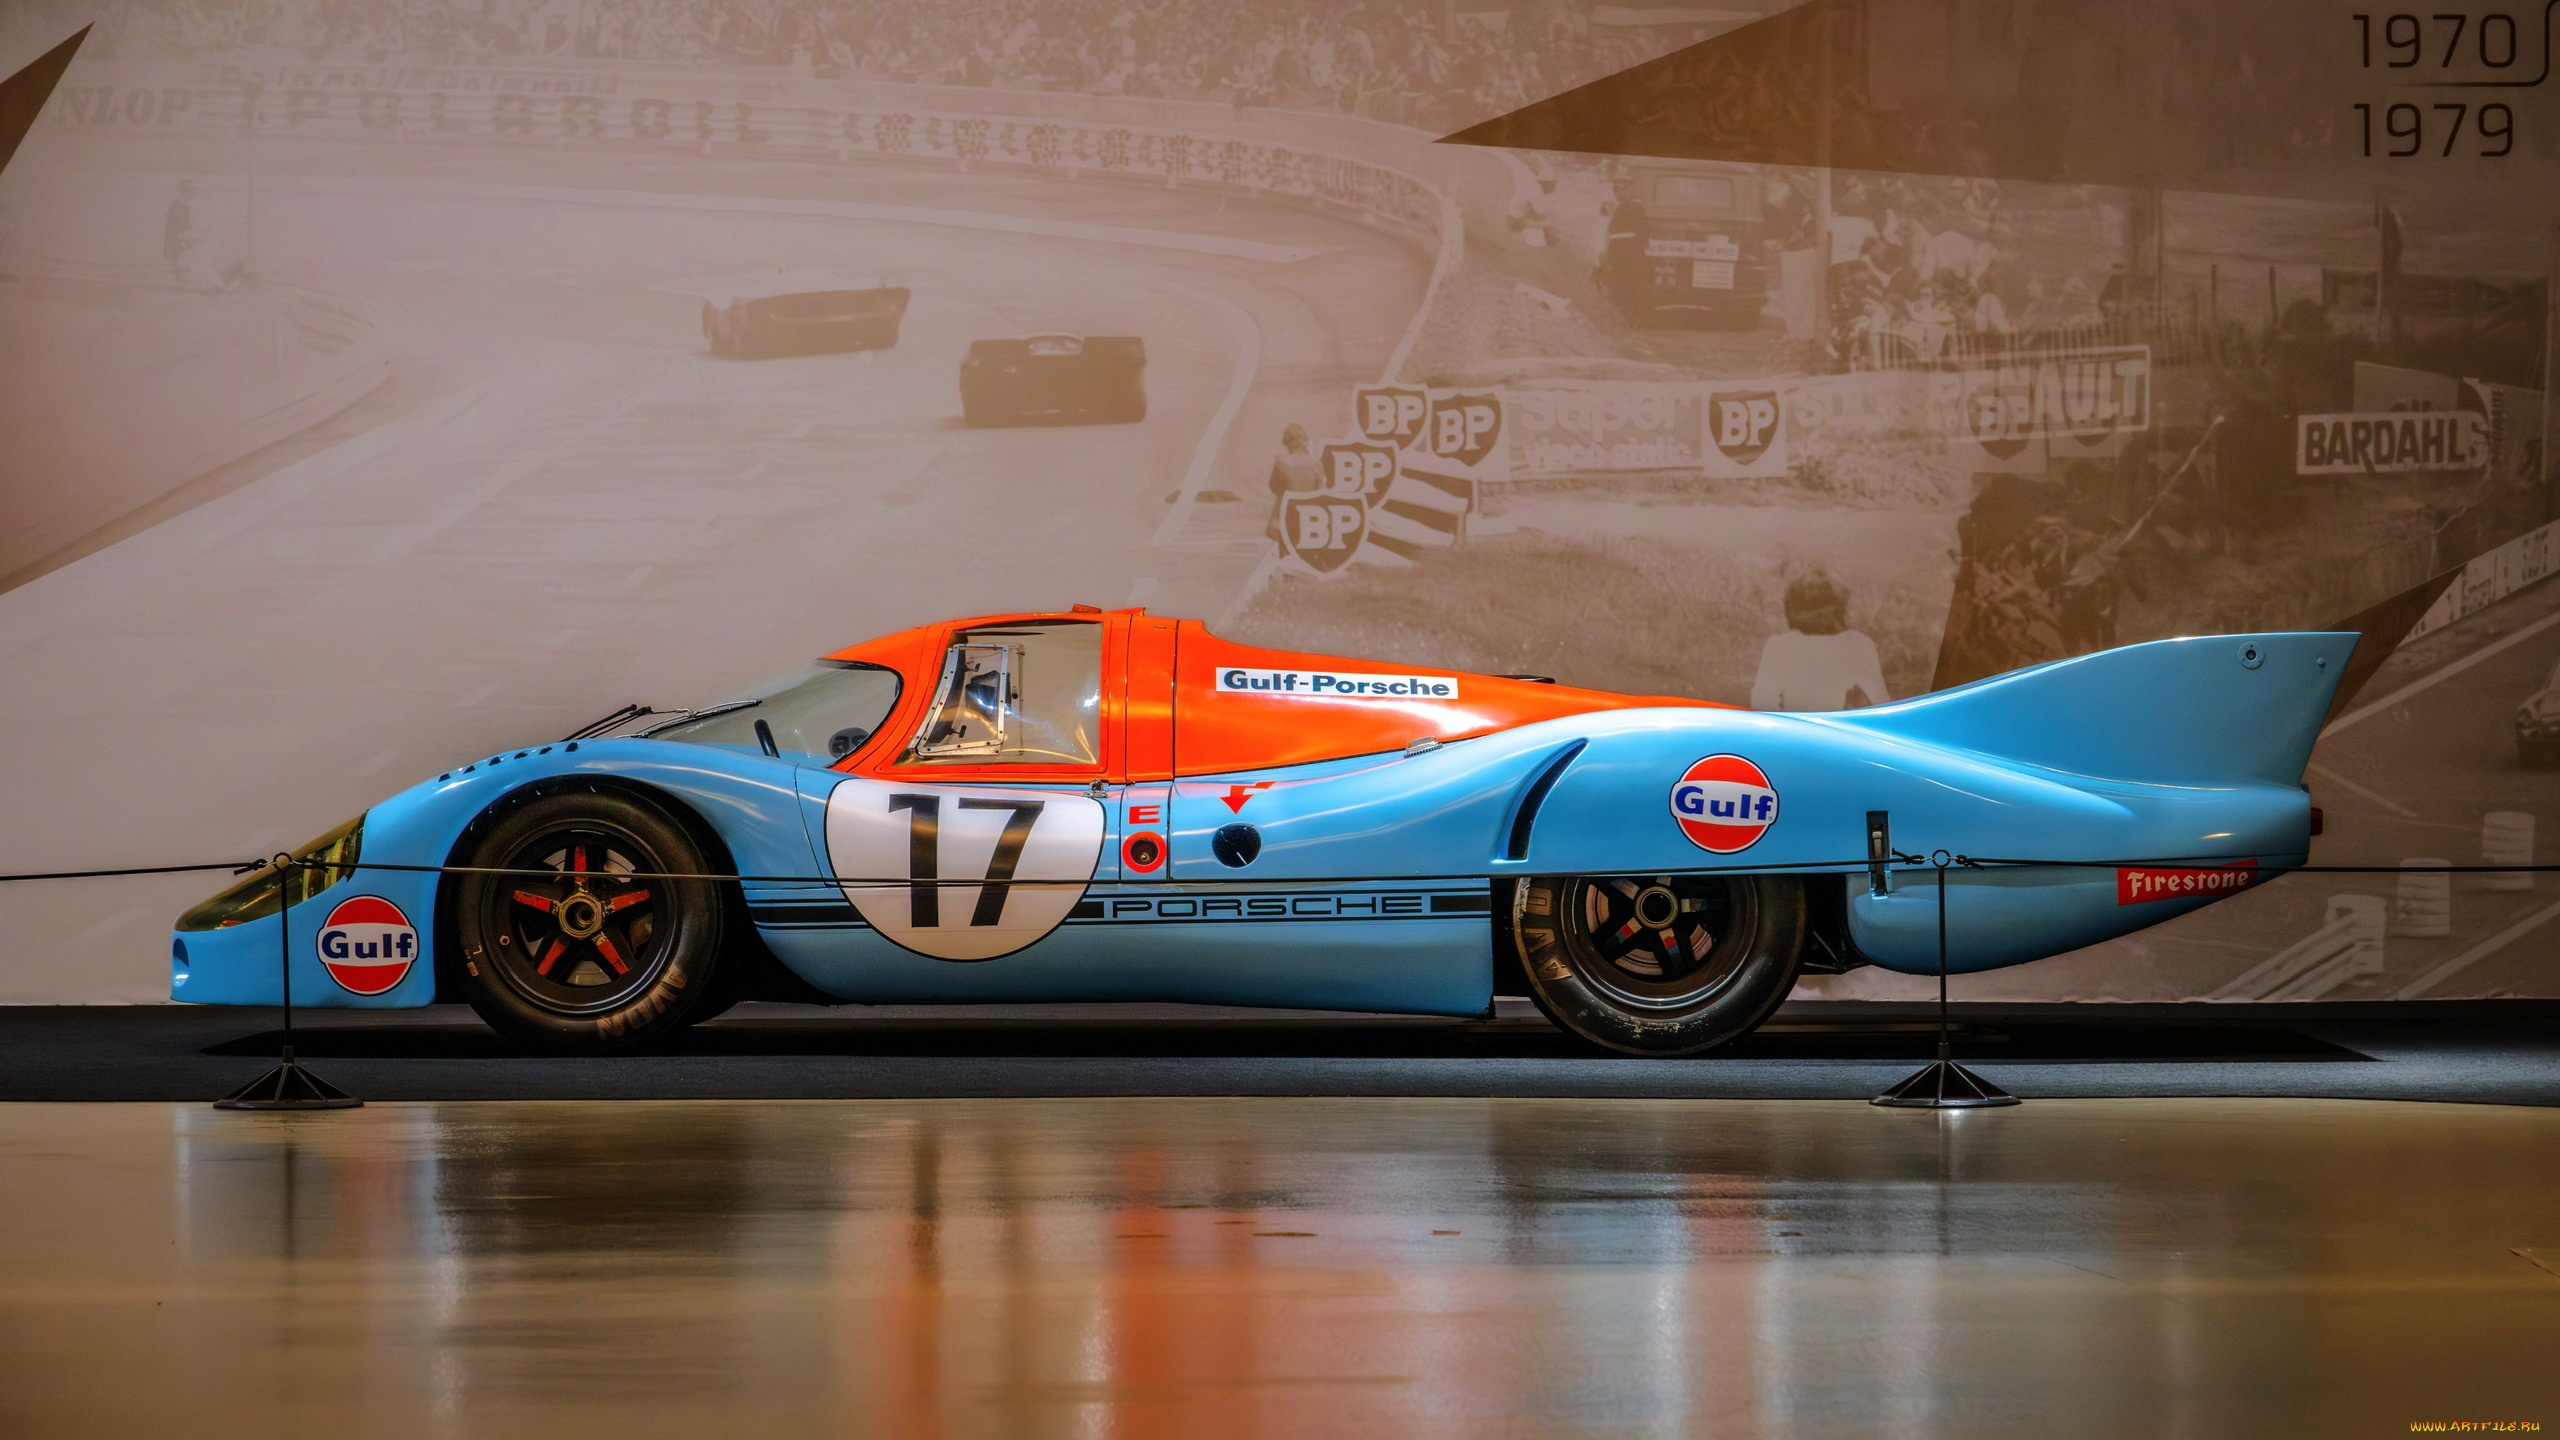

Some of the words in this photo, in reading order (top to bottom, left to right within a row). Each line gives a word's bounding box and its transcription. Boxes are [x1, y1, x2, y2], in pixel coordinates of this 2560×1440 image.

[2352, 13, 2517, 69] 1970
[52, 86, 193, 127] NLOP
[2353, 102, 2515, 158] 1979
[1365, 394, 1424, 436] BP
[1437, 404, 1496, 455] BP
[1718, 399, 1775, 448] BP
[2305, 418, 2467, 479] BARDAHL
[1331, 449, 1392, 495] BP
[1296, 503, 1362, 551] BP
[1223, 669, 1451, 697] Gulf-Porsche
[1128, 804, 1162, 825] E
[1674, 785, 1774, 821] Gulf
[888, 793, 1046, 928] 17
[1111, 896, 1423, 918] PORSCHE
[2126, 870, 2249, 898] Firestone
[321, 930, 413, 959] Gulf
[1524, 886, 1573, 982] AVO
